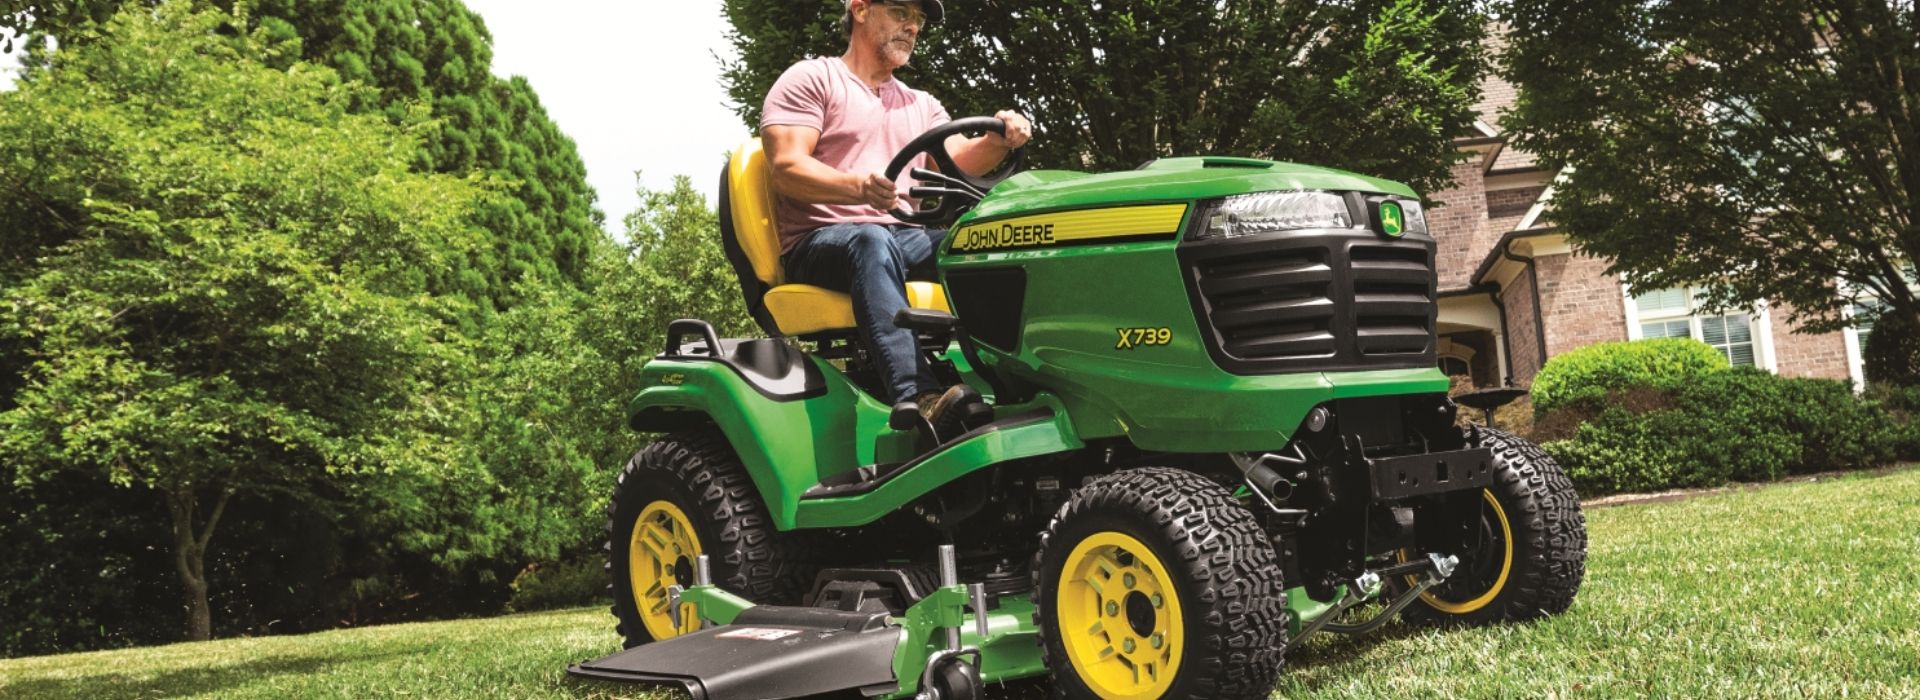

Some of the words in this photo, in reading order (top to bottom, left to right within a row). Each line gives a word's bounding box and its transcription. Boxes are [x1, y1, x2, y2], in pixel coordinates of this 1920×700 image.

[963, 228, 998, 247] JOHN
[1002, 224, 1054, 244] DEERE
[1116, 327, 1172, 349] X739
